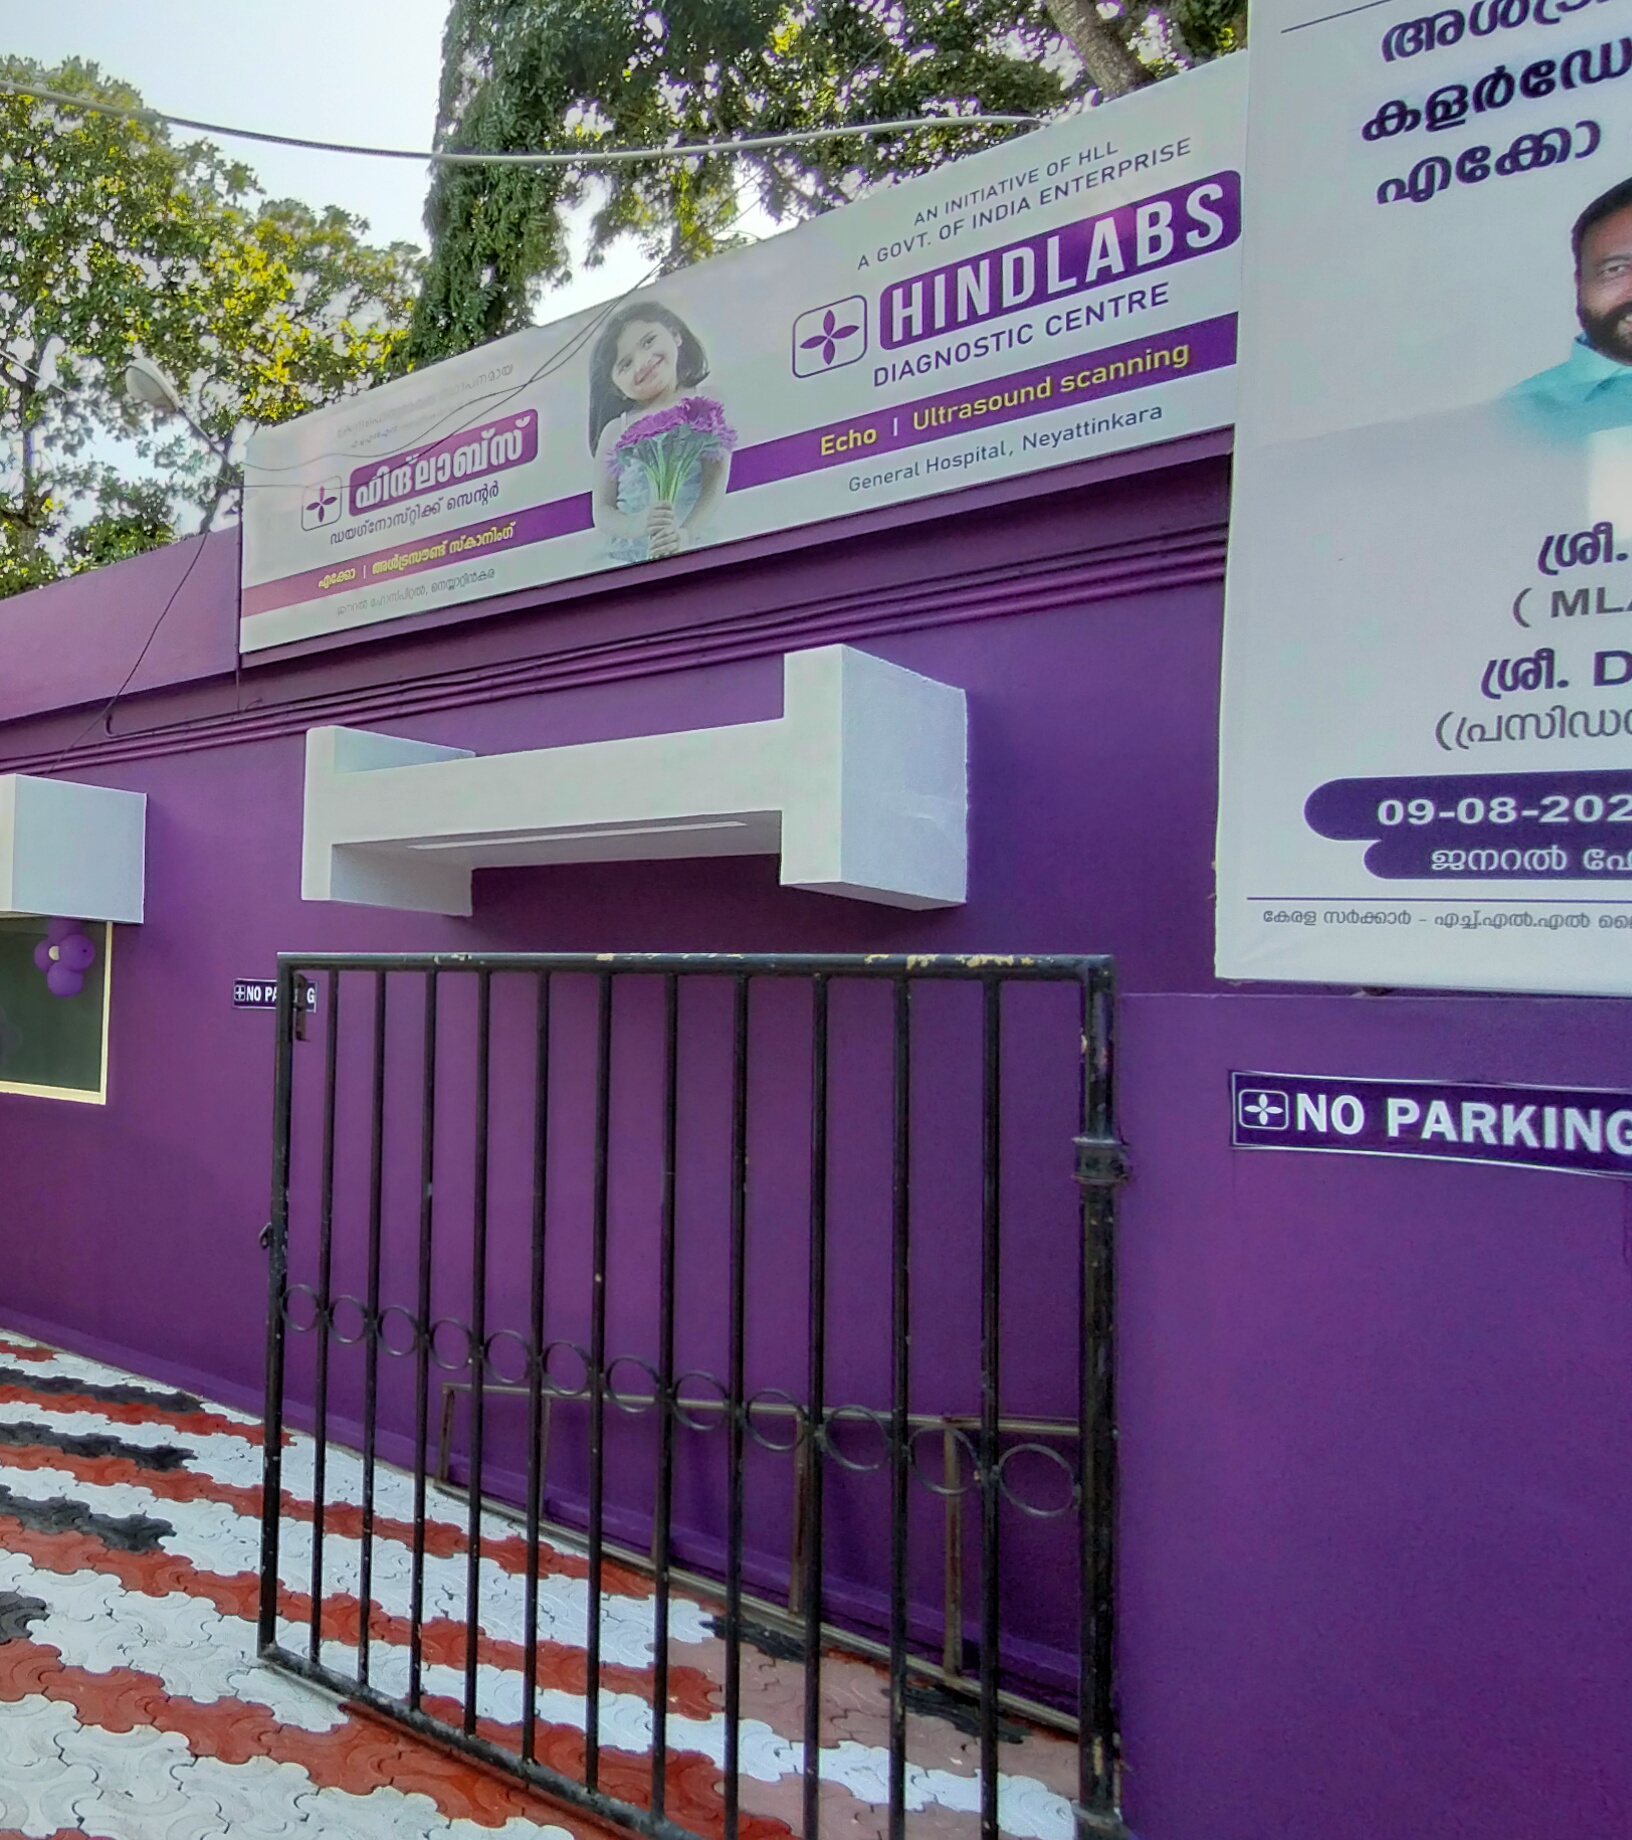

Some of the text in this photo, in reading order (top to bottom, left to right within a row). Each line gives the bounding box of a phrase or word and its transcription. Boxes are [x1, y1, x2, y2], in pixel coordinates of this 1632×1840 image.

[857, 138, 1192, 270] A GOVT. OF INDIA ENTERPRISE
[914, 141, 1118, 226] AN INITIATIVE OF HLL
[1376, 120, 1602, 204] എക്കോ
[891, 182, 1225, 343] HINDLABS
[873, 282, 1170, 387] DIAGNOSTIC CENTRE
[820, 343, 1190, 456] Echo Ultrasound scanning
[848, 405, 1163, 492] General Hospital, Neyattinkara
[1550, 586, 1632, 618] ML
[1431, 843, 1567, 872] ജനറൽ
[1262, 909, 1317, 927] കേരള
[1323, 908, 1412, 926] സർക്കാർ
[246, 985, 262, 1002] NO
[1295, 1092, 1632, 1156] NO PARKING
